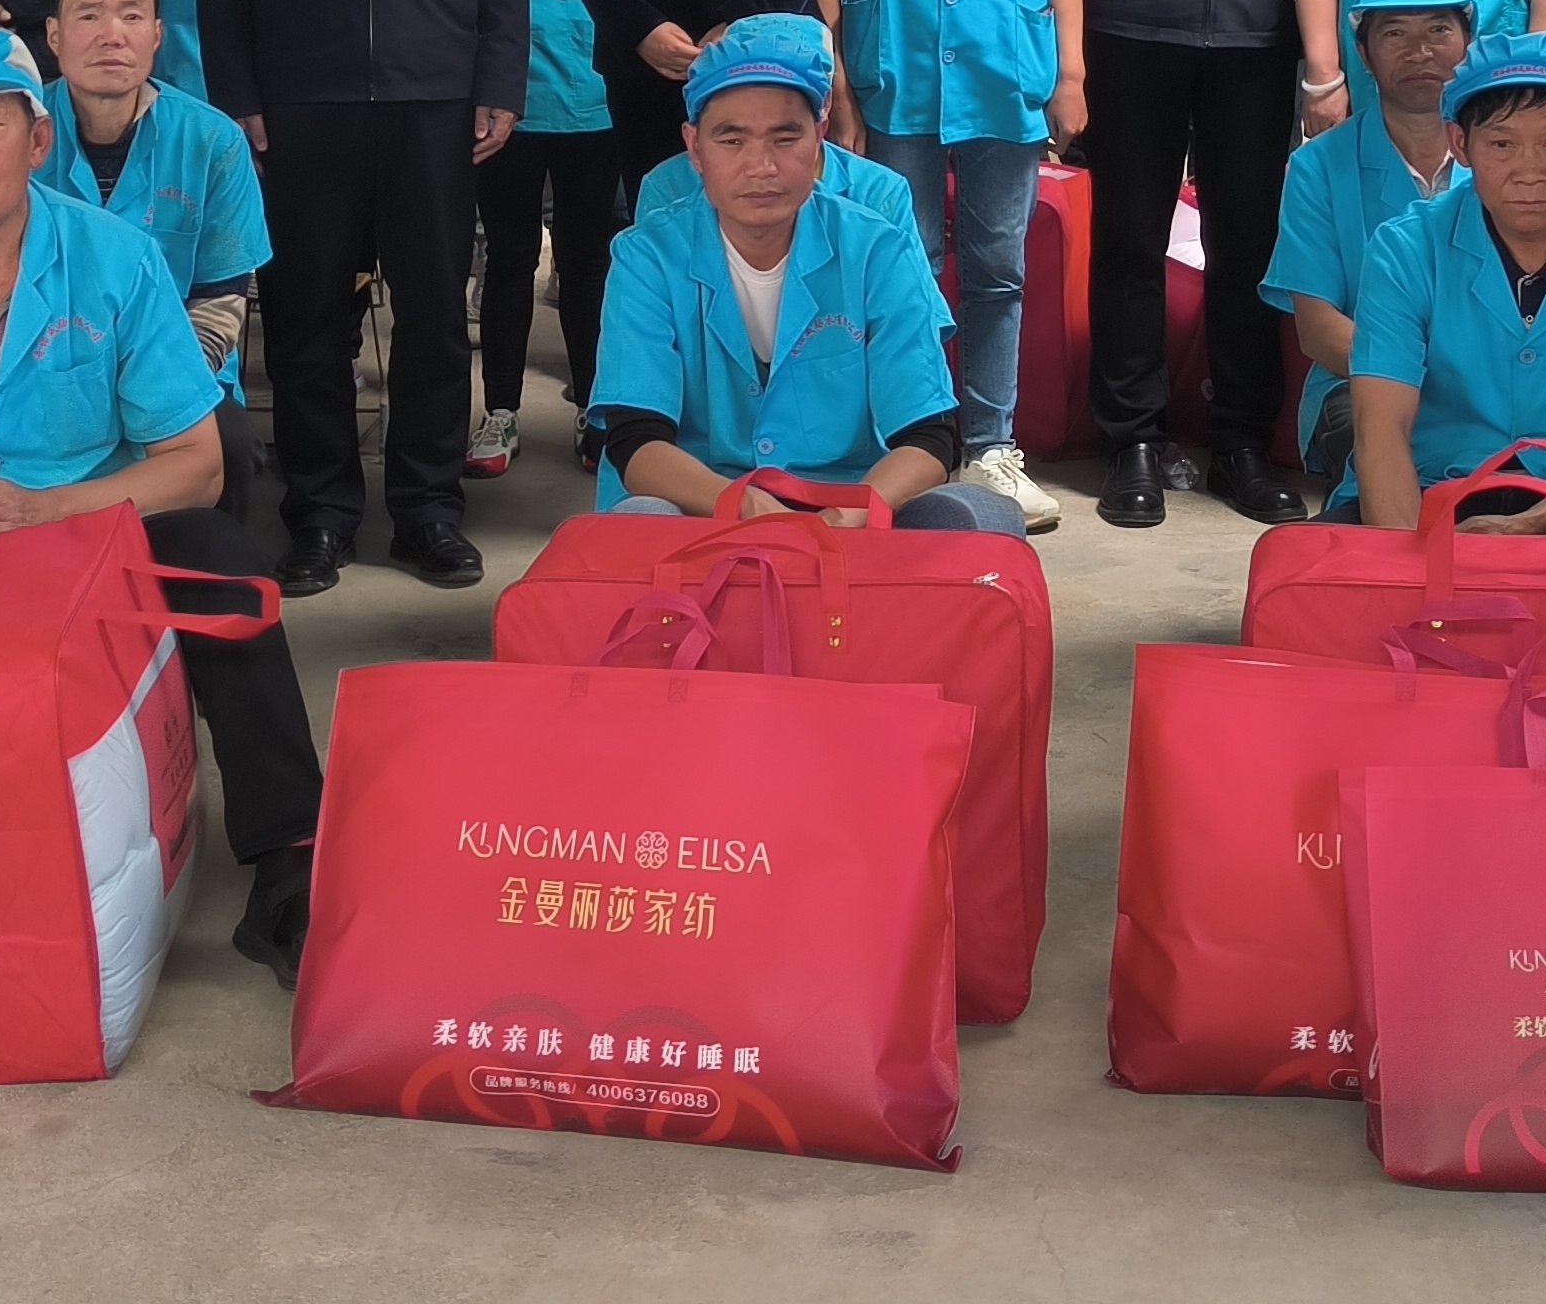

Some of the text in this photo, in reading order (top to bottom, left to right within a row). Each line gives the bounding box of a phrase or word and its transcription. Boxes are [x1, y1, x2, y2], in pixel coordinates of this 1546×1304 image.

[458, 820, 772, 875] KINGMAN ELISA
[496, 876, 717, 940] 金曼丽莎家纺
[432, 1018, 761, 1074] 柔软亲肤 健康好睡眠
[1289, 1026, 1355, 1054] 柔软
[586, 1082, 709, 1109] 4006376088
